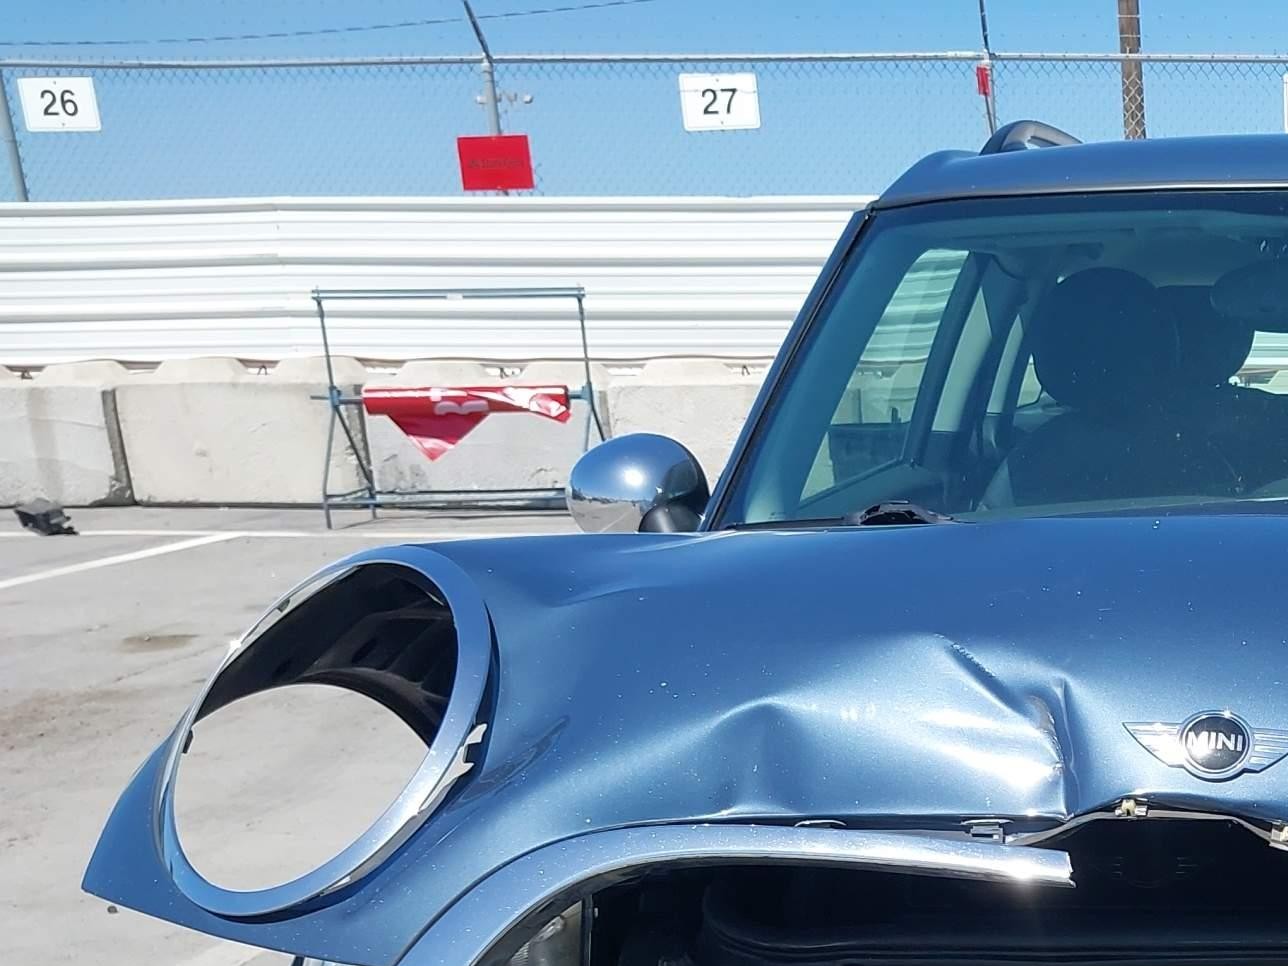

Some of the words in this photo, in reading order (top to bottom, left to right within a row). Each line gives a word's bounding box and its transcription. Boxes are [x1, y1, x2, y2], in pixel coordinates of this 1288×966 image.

[40, 89, 78, 117] 26
[701, 88, 737, 115] 27
[1187, 730, 1244, 752] MINI
